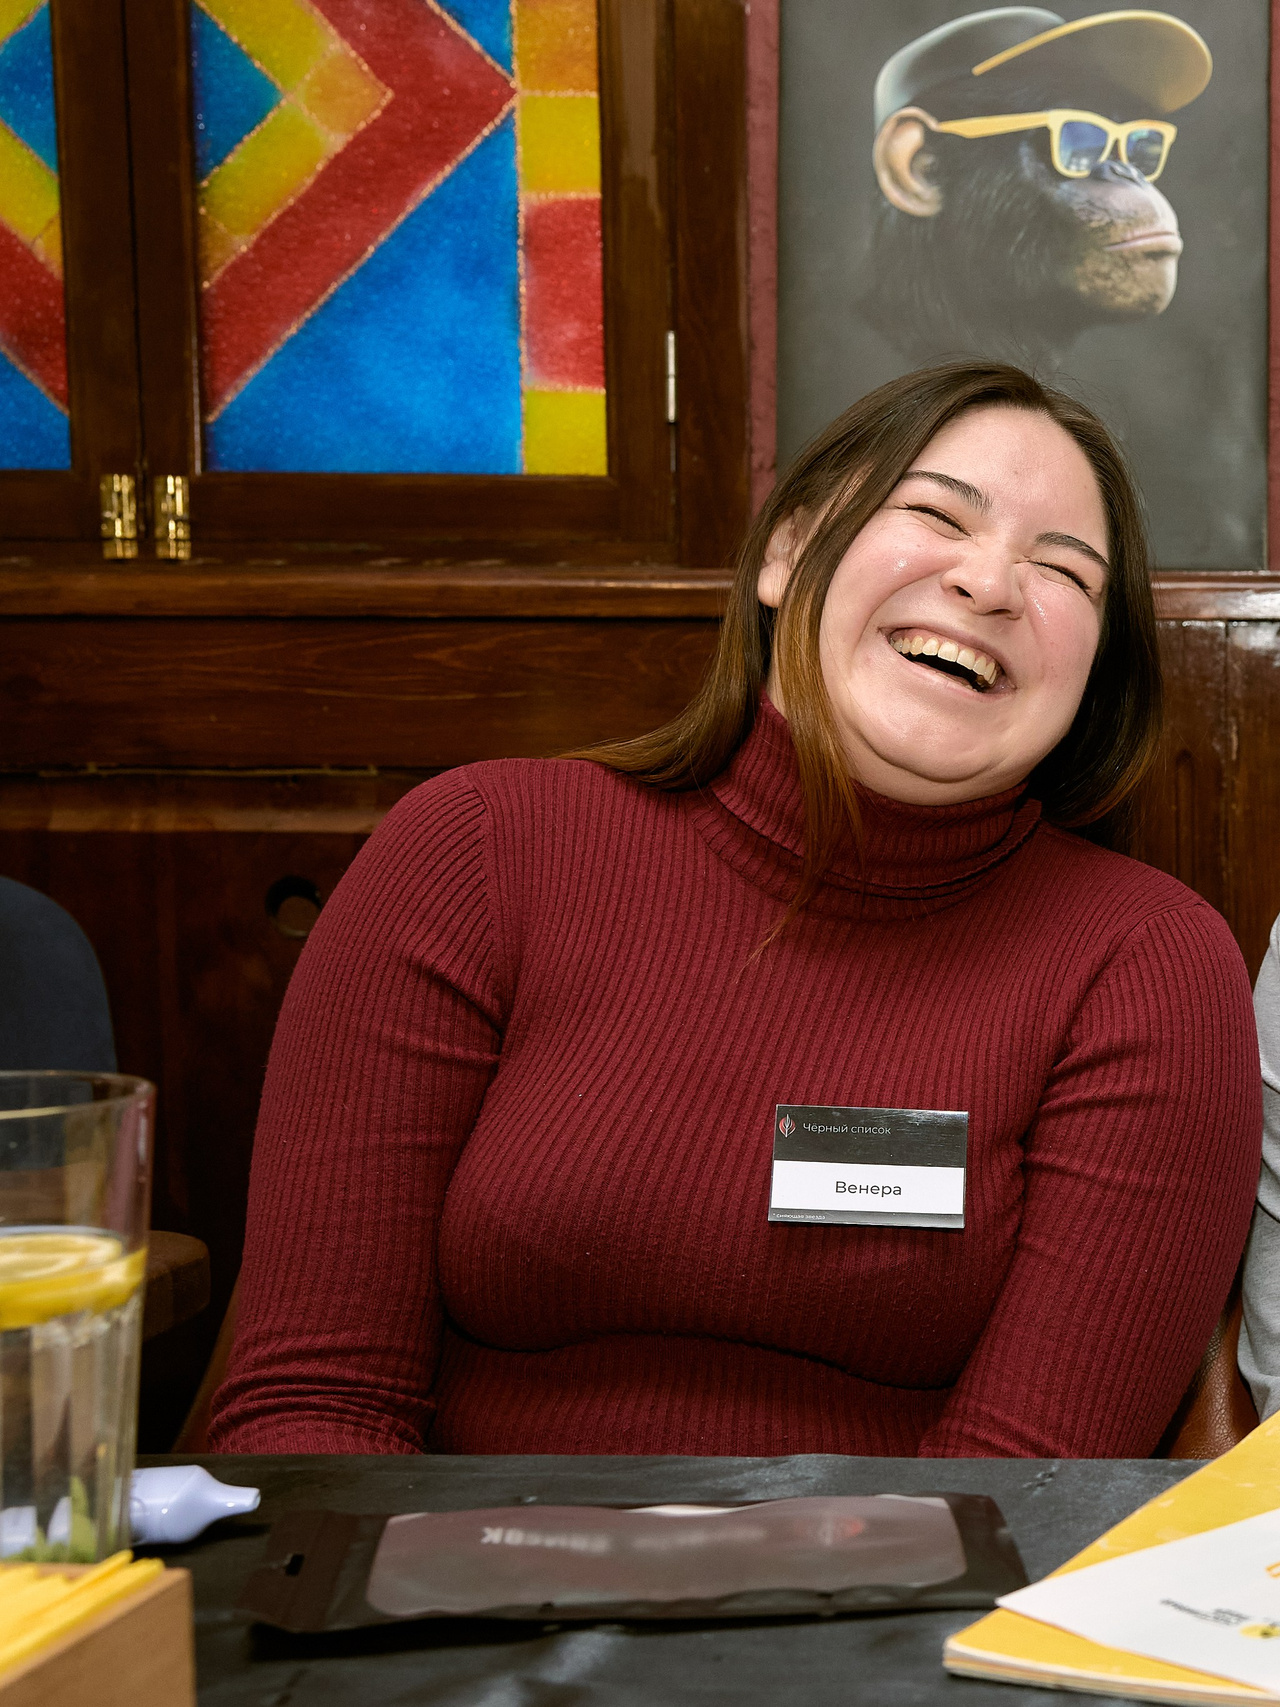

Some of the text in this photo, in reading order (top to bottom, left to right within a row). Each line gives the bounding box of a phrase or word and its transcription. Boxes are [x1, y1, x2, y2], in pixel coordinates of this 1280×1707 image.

[803, 1122, 892, 1135] Чёрный список
[835, 1181, 902, 1198] Венера
